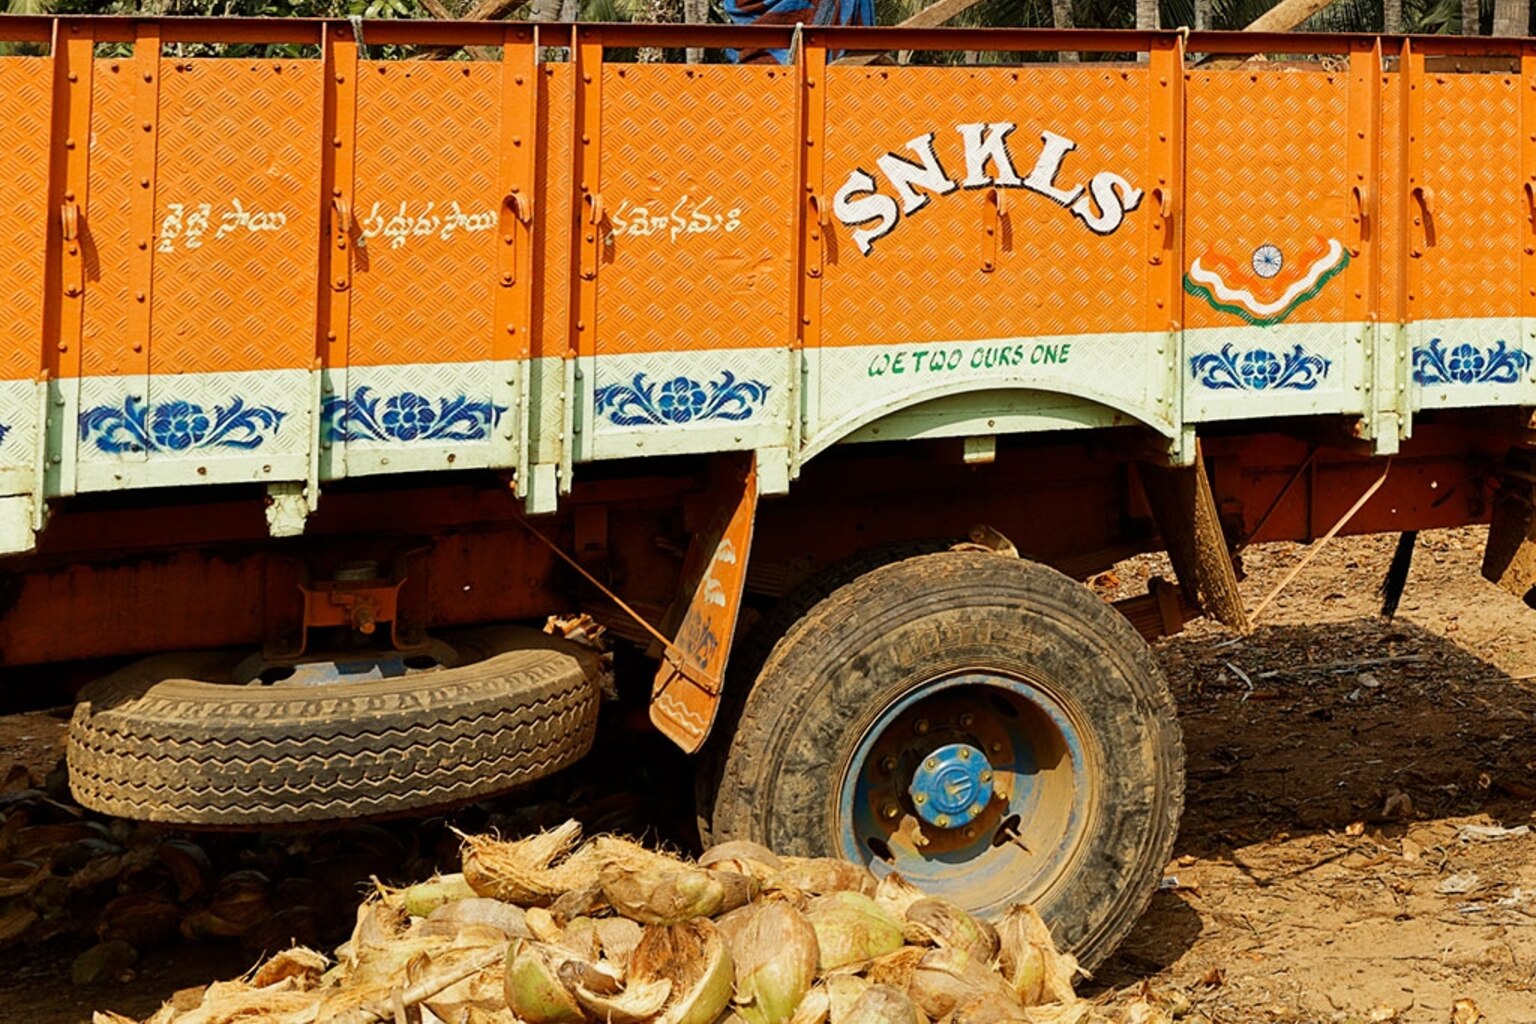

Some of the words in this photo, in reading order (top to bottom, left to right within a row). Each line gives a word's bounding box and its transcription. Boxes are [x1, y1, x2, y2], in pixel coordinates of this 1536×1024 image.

[832, 122, 1145, 257] SNKLS
[215, 197, 287, 239] సాయి
[868, 351, 907, 377] WE
[912, 348, 963, 373] TWO
[970, 344, 1023, 369] OURS
[1030, 343, 1071, 365] ONE
